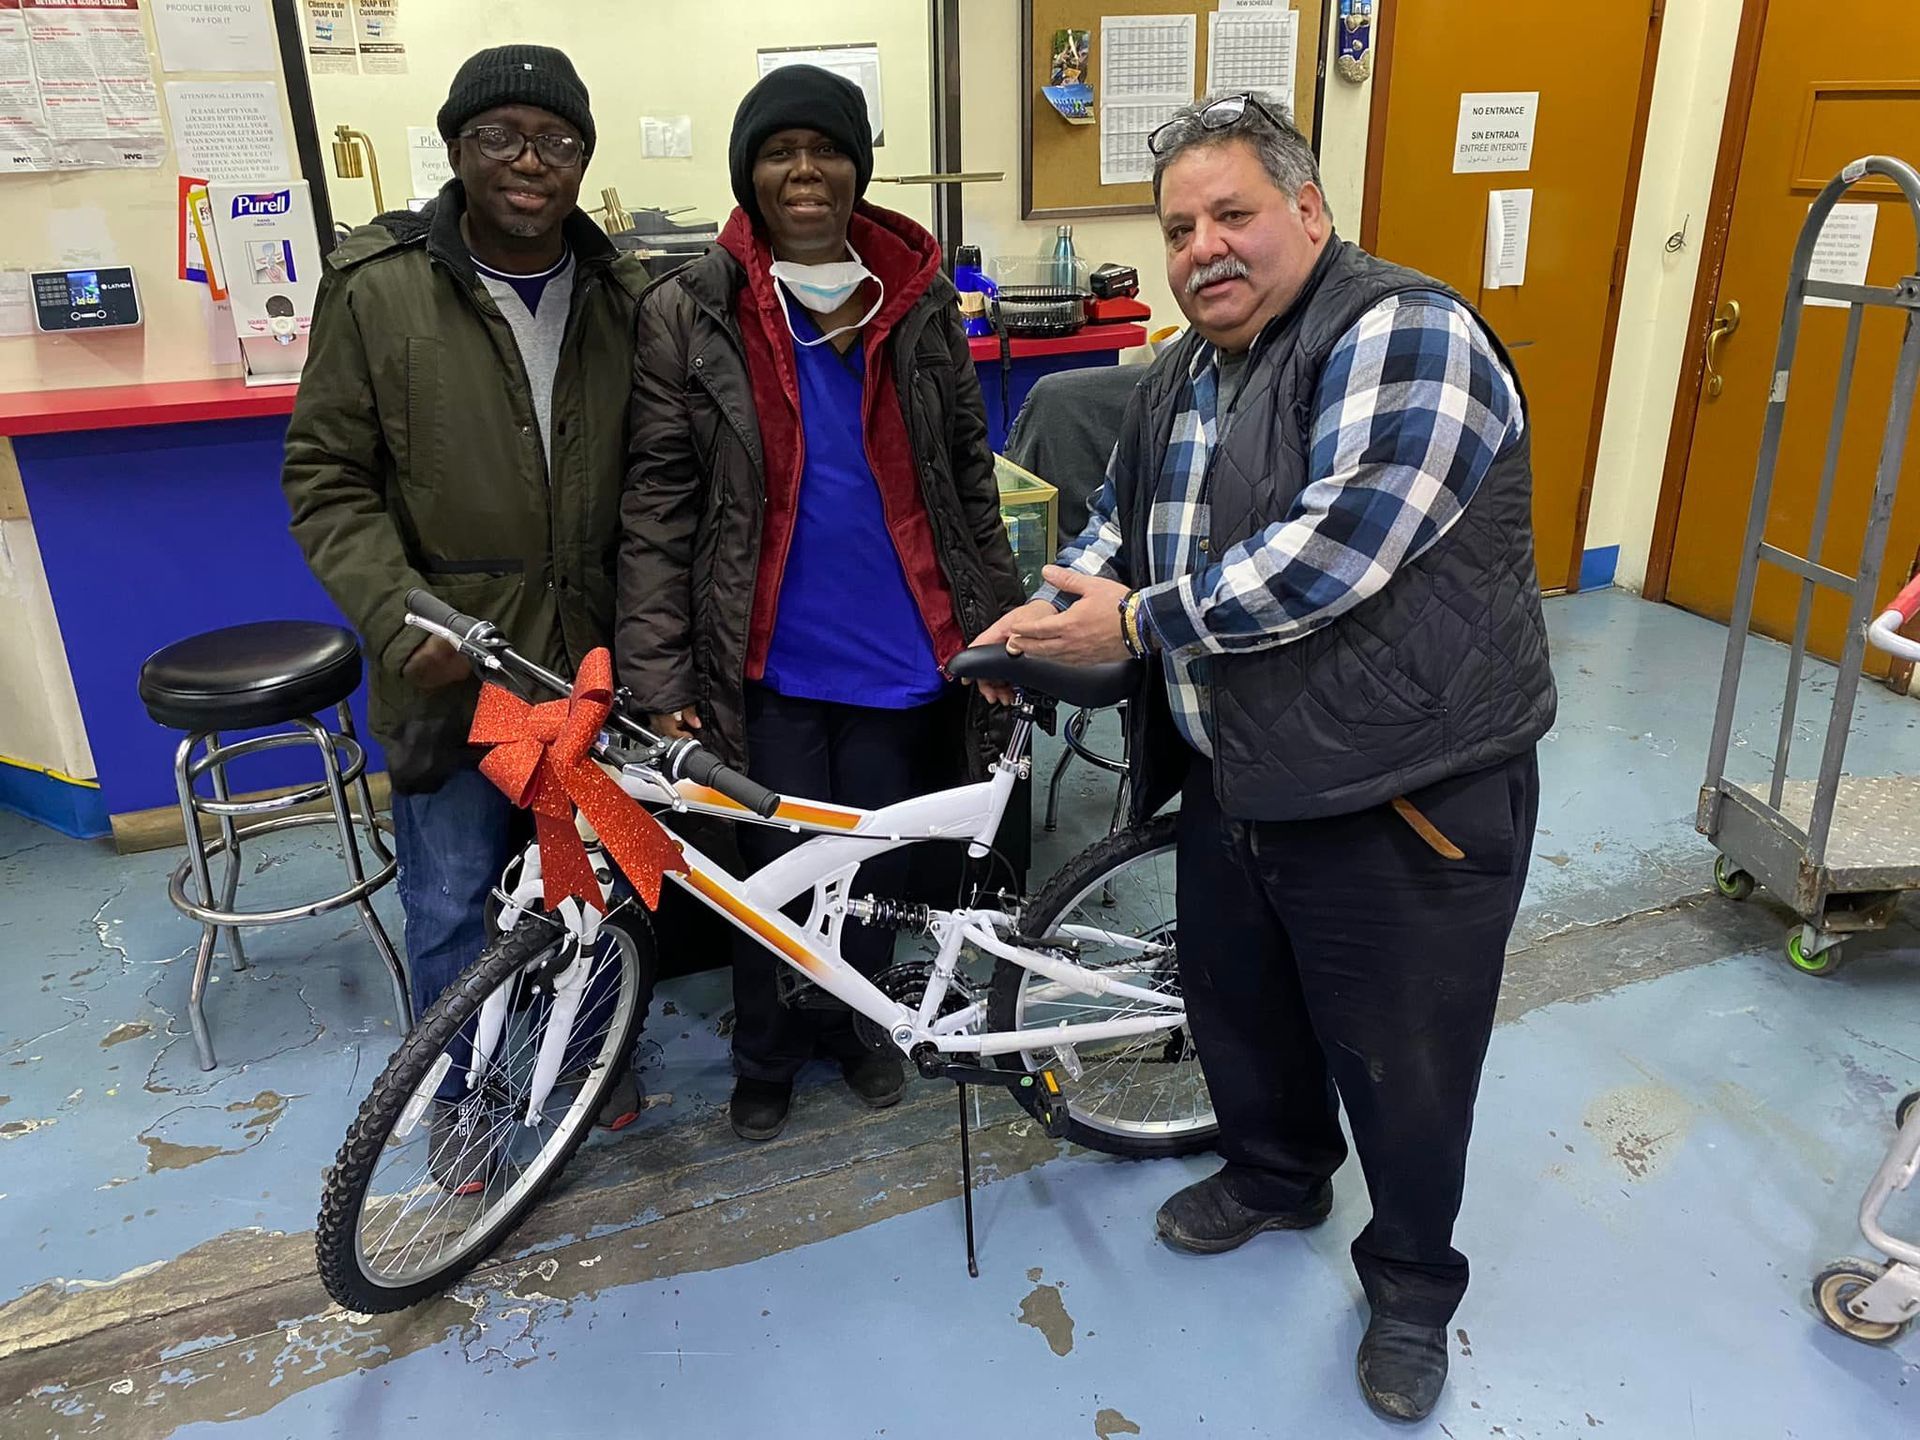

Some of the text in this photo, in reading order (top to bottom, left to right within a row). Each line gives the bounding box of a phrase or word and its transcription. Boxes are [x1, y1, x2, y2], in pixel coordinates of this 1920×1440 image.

[166, 4, 202, 12] PRODUCT
[204, 4, 232, 12] BEFORE
[308, 0, 336, 9] Clientes
[1472, 106, 1525, 115] NO ENTRANCE
[1471, 130, 1519, 140] SIN ENTRADA
[1460, 142, 1527, 152] ENTRÉE INTERDITE
[421, 161, 441, 170] Keep
[236, 195, 287, 213] Purell
[107, 281, 132, 291] LATHEM
